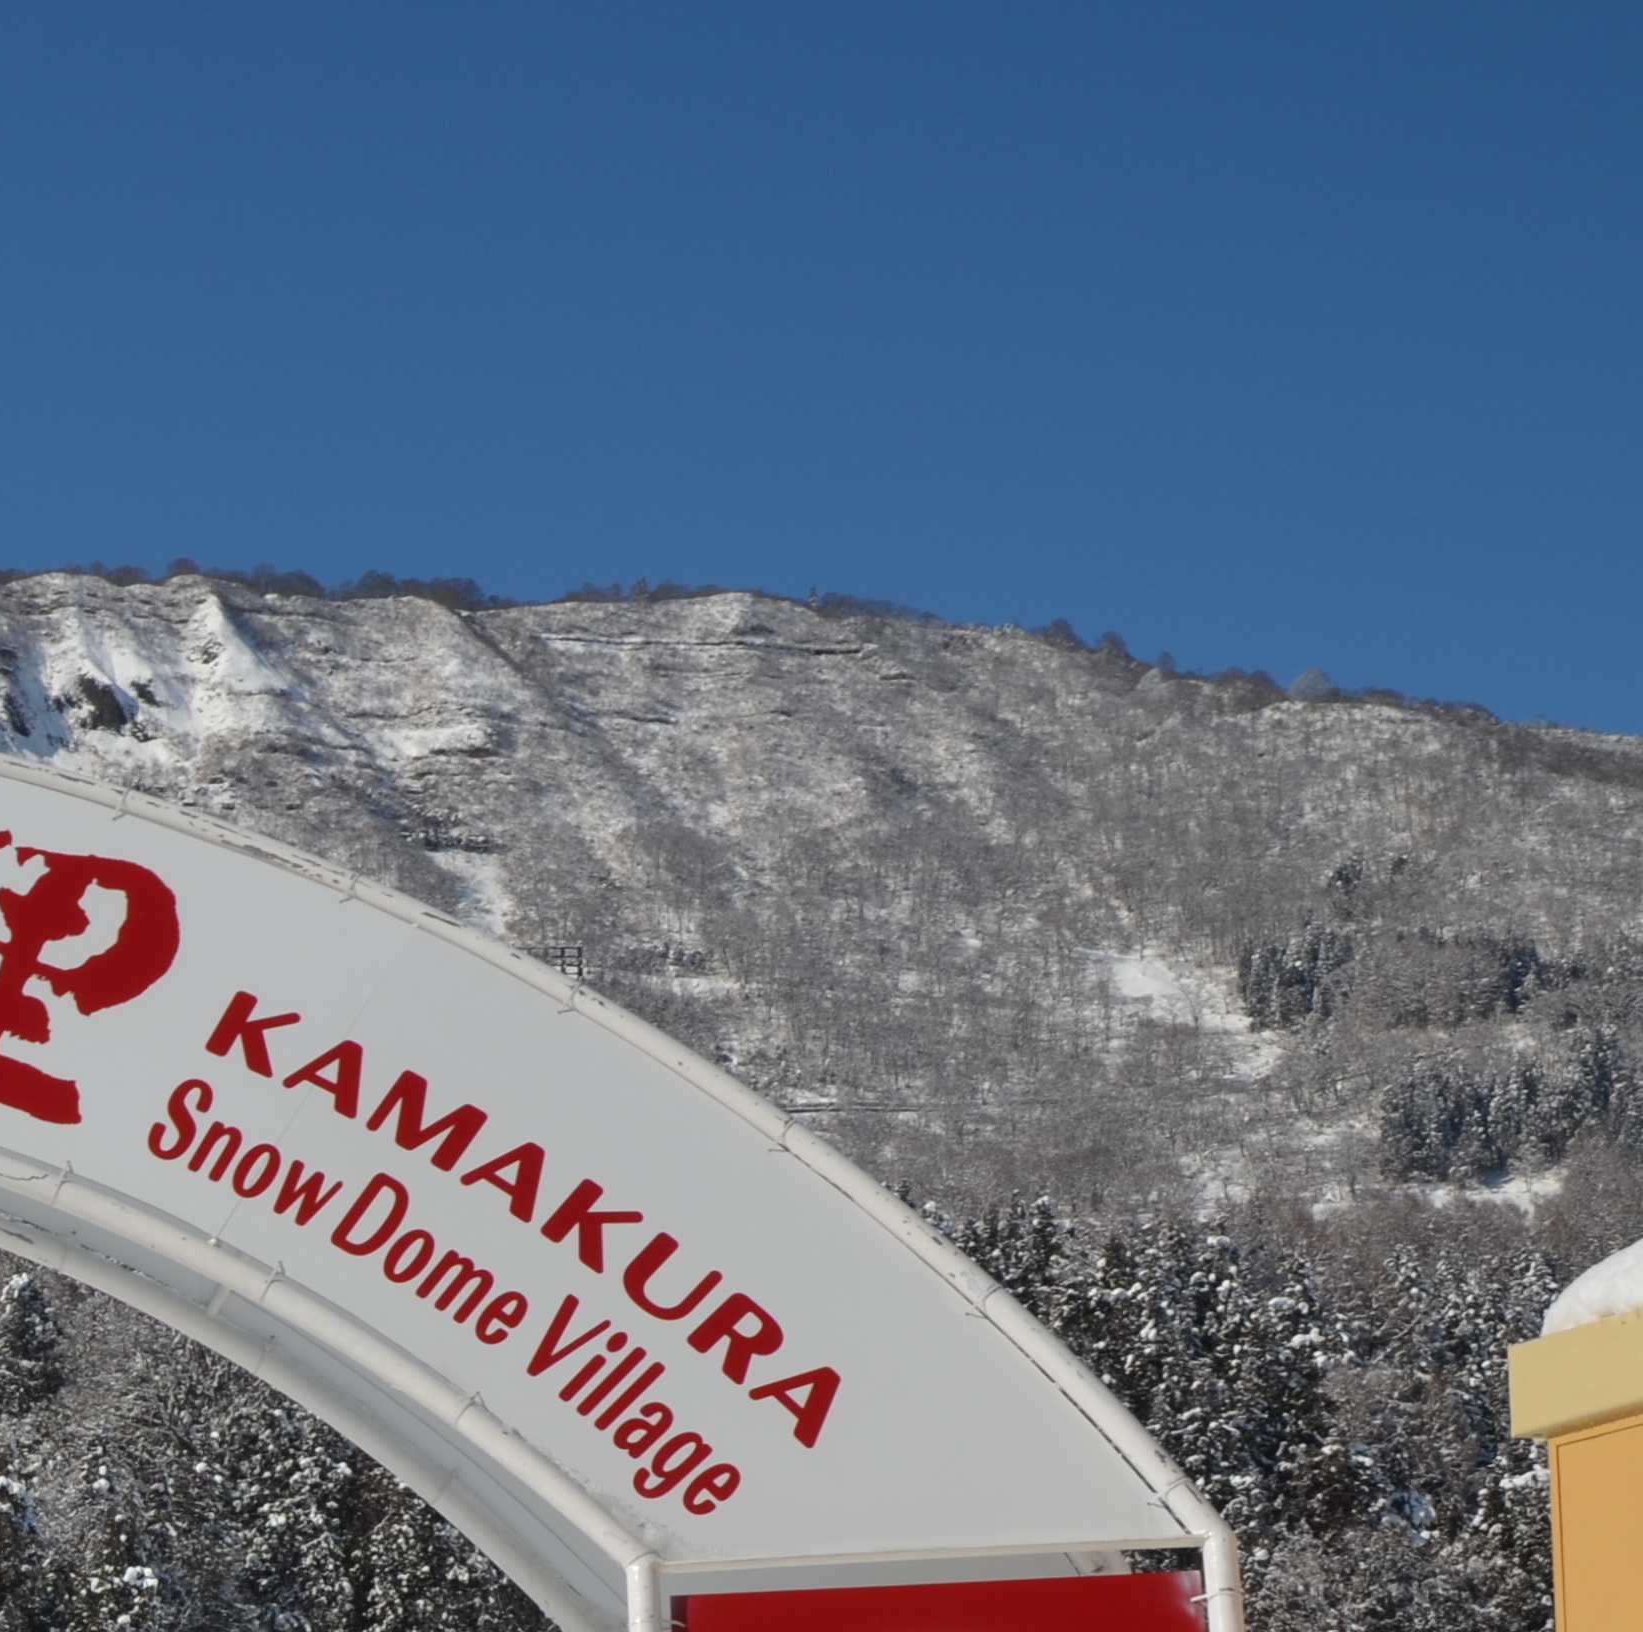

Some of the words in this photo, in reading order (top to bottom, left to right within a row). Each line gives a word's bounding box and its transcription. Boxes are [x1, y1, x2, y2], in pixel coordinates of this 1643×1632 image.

[147, 1078, 344, 1227] Snow
[330, 1171, 529, 1346] Dome
[526, 1294, 742, 1516] Village
[205, 990, 842, 1449] KAMAKURA
